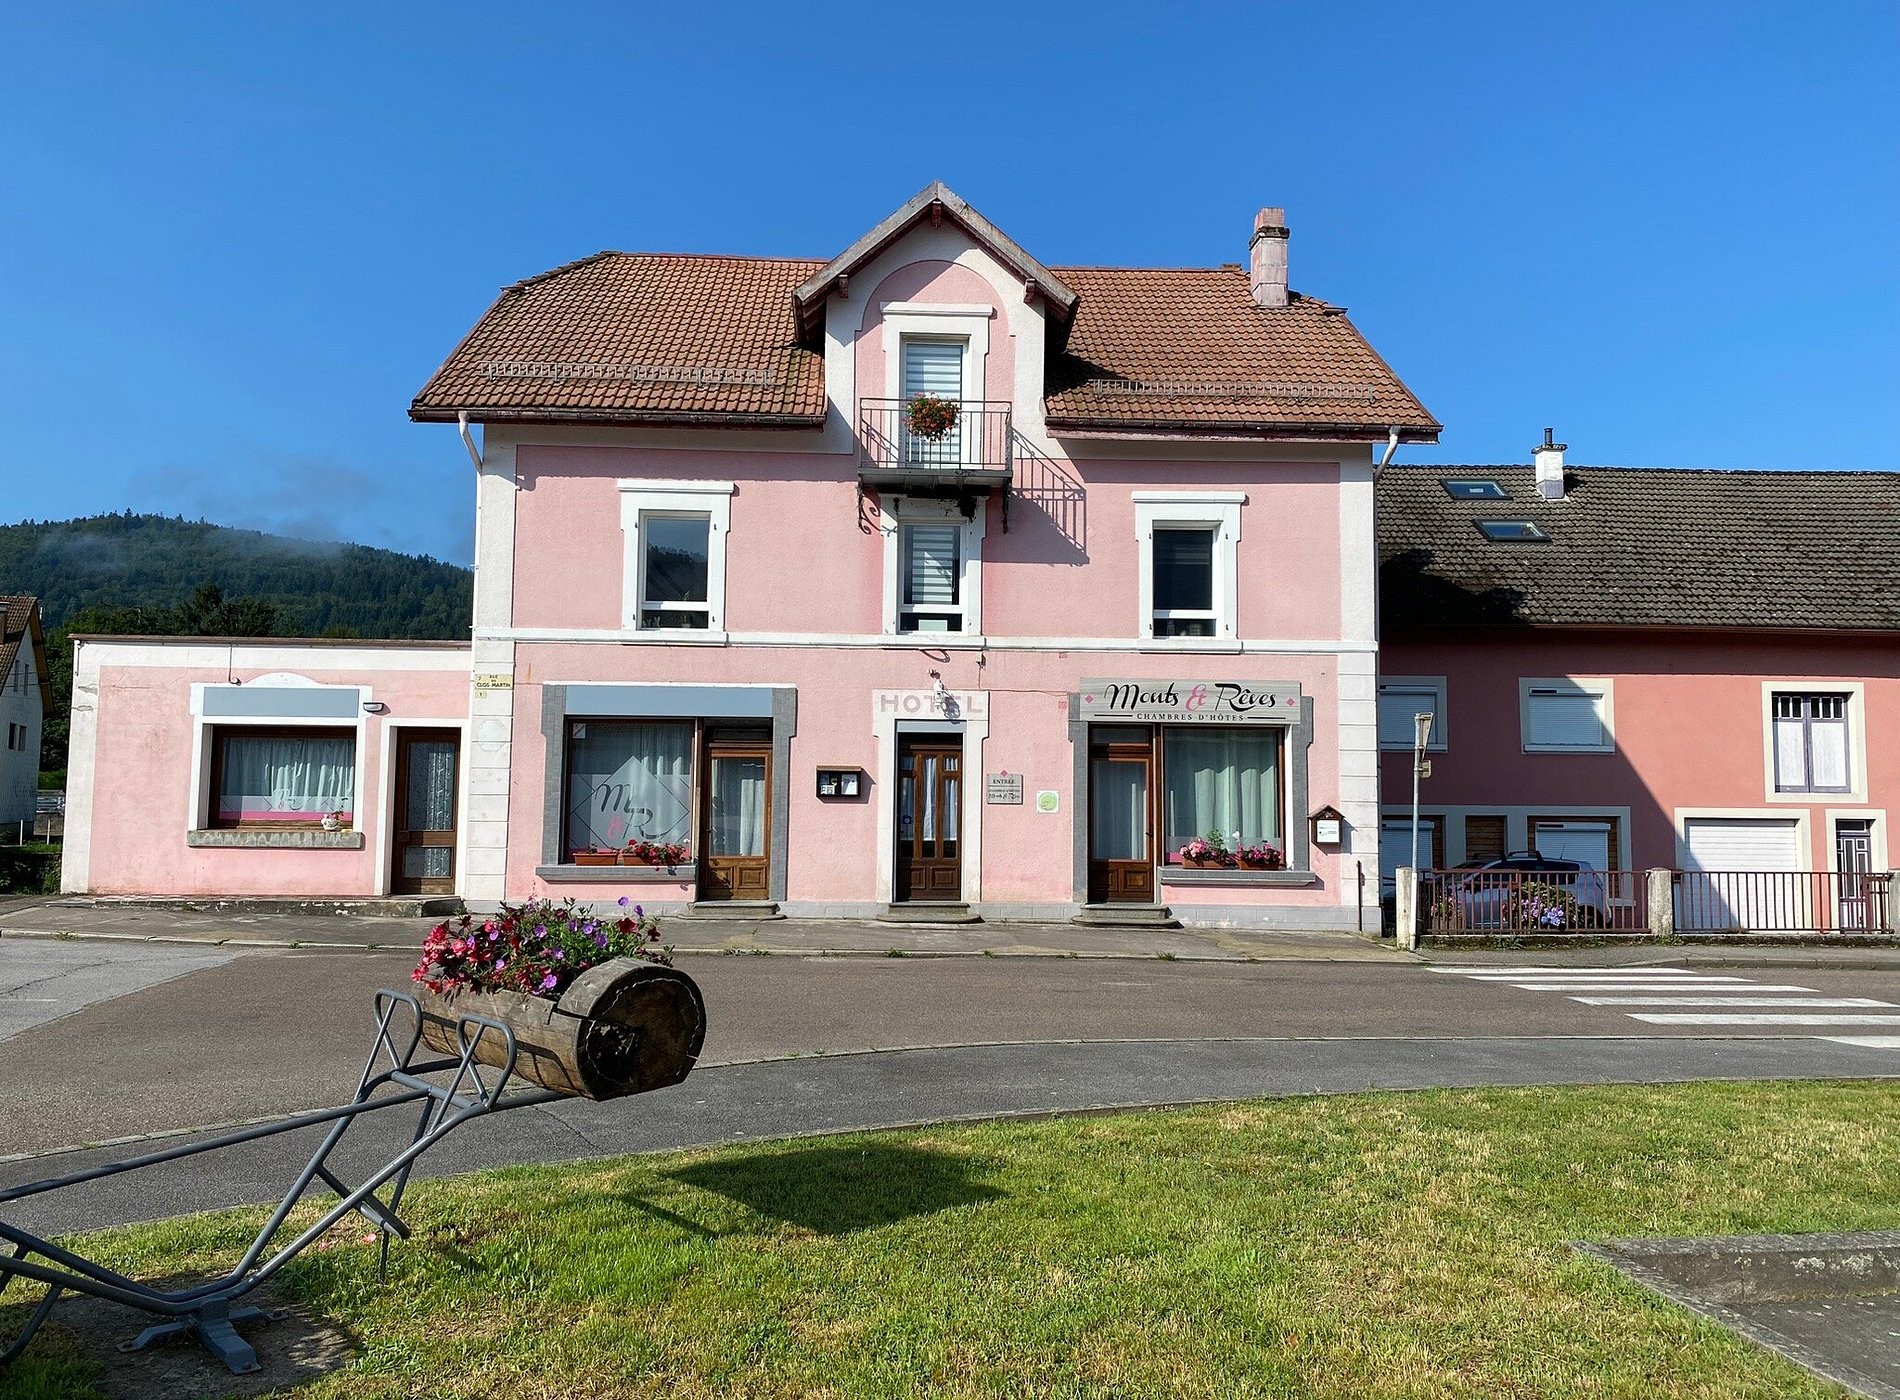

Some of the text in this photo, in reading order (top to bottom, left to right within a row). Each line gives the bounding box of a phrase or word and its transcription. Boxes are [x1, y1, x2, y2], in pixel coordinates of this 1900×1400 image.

[1103, 682, 1276, 712] Monts & Rêves
[1136, 713, 1244, 721] CHAMBRES D'HÔTES
